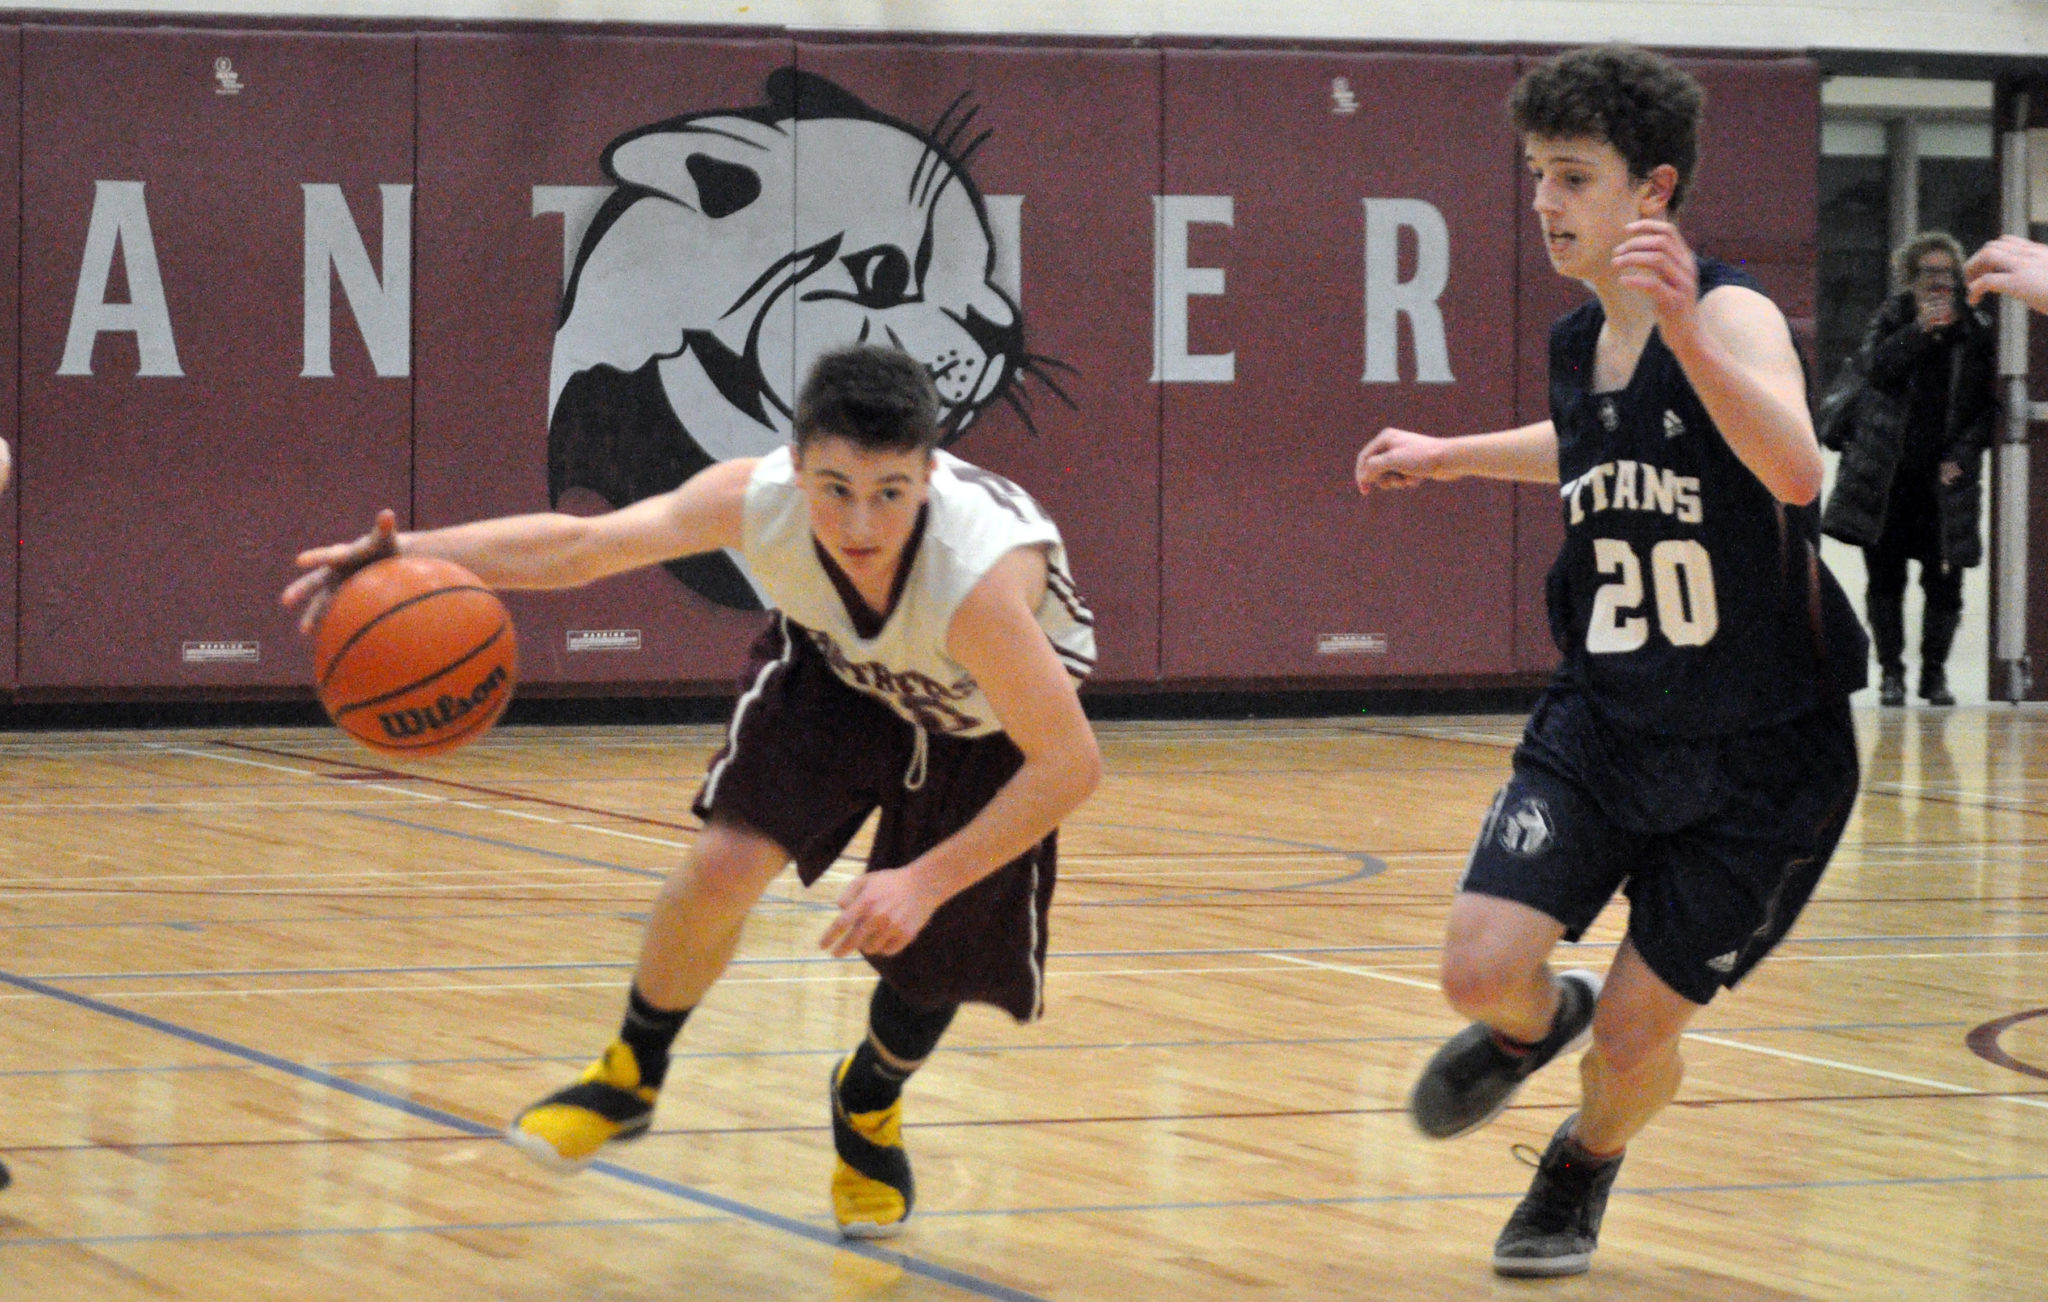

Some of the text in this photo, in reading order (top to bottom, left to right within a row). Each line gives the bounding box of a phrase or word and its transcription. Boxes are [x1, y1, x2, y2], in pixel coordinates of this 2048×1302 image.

[56, 180, 1455, 384] ANTER
[1586, 538, 1719, 653] 20
[379, 664, 507, 738] Wilson
